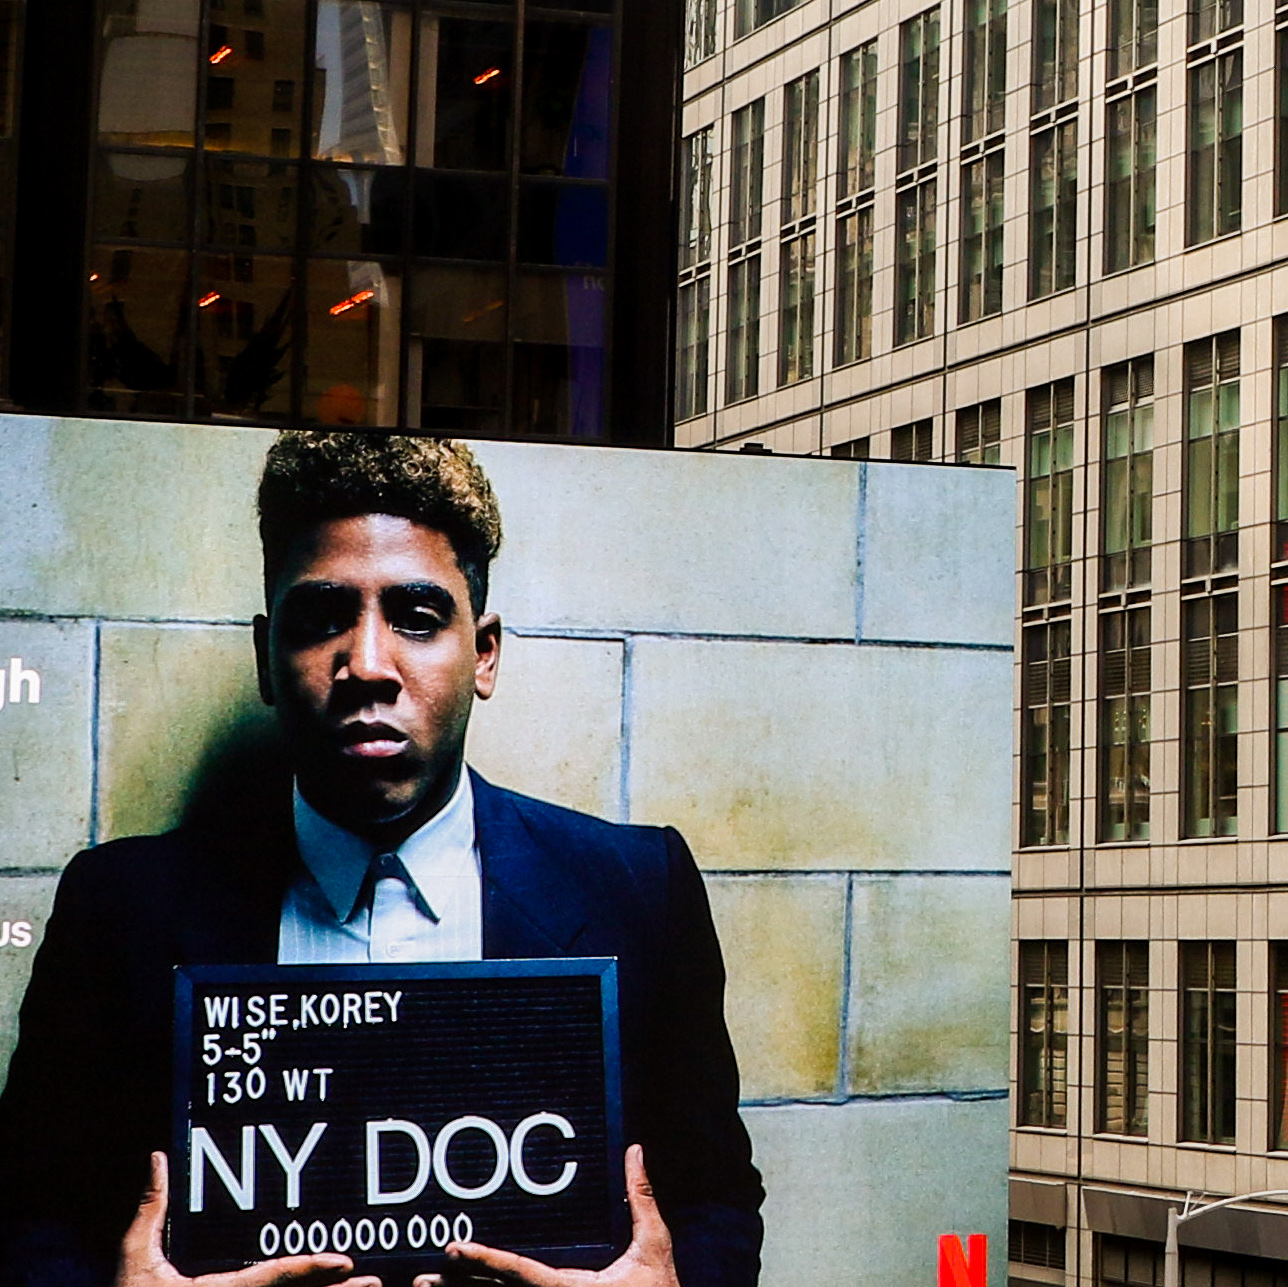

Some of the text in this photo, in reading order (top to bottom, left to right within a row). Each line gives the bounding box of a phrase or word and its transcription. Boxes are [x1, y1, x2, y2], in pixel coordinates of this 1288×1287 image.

[206, 1066, 334, 1106] 130 WT
[188, 1111, 579, 1212] NY DOC
[937, 1233, 988, 1287] N
